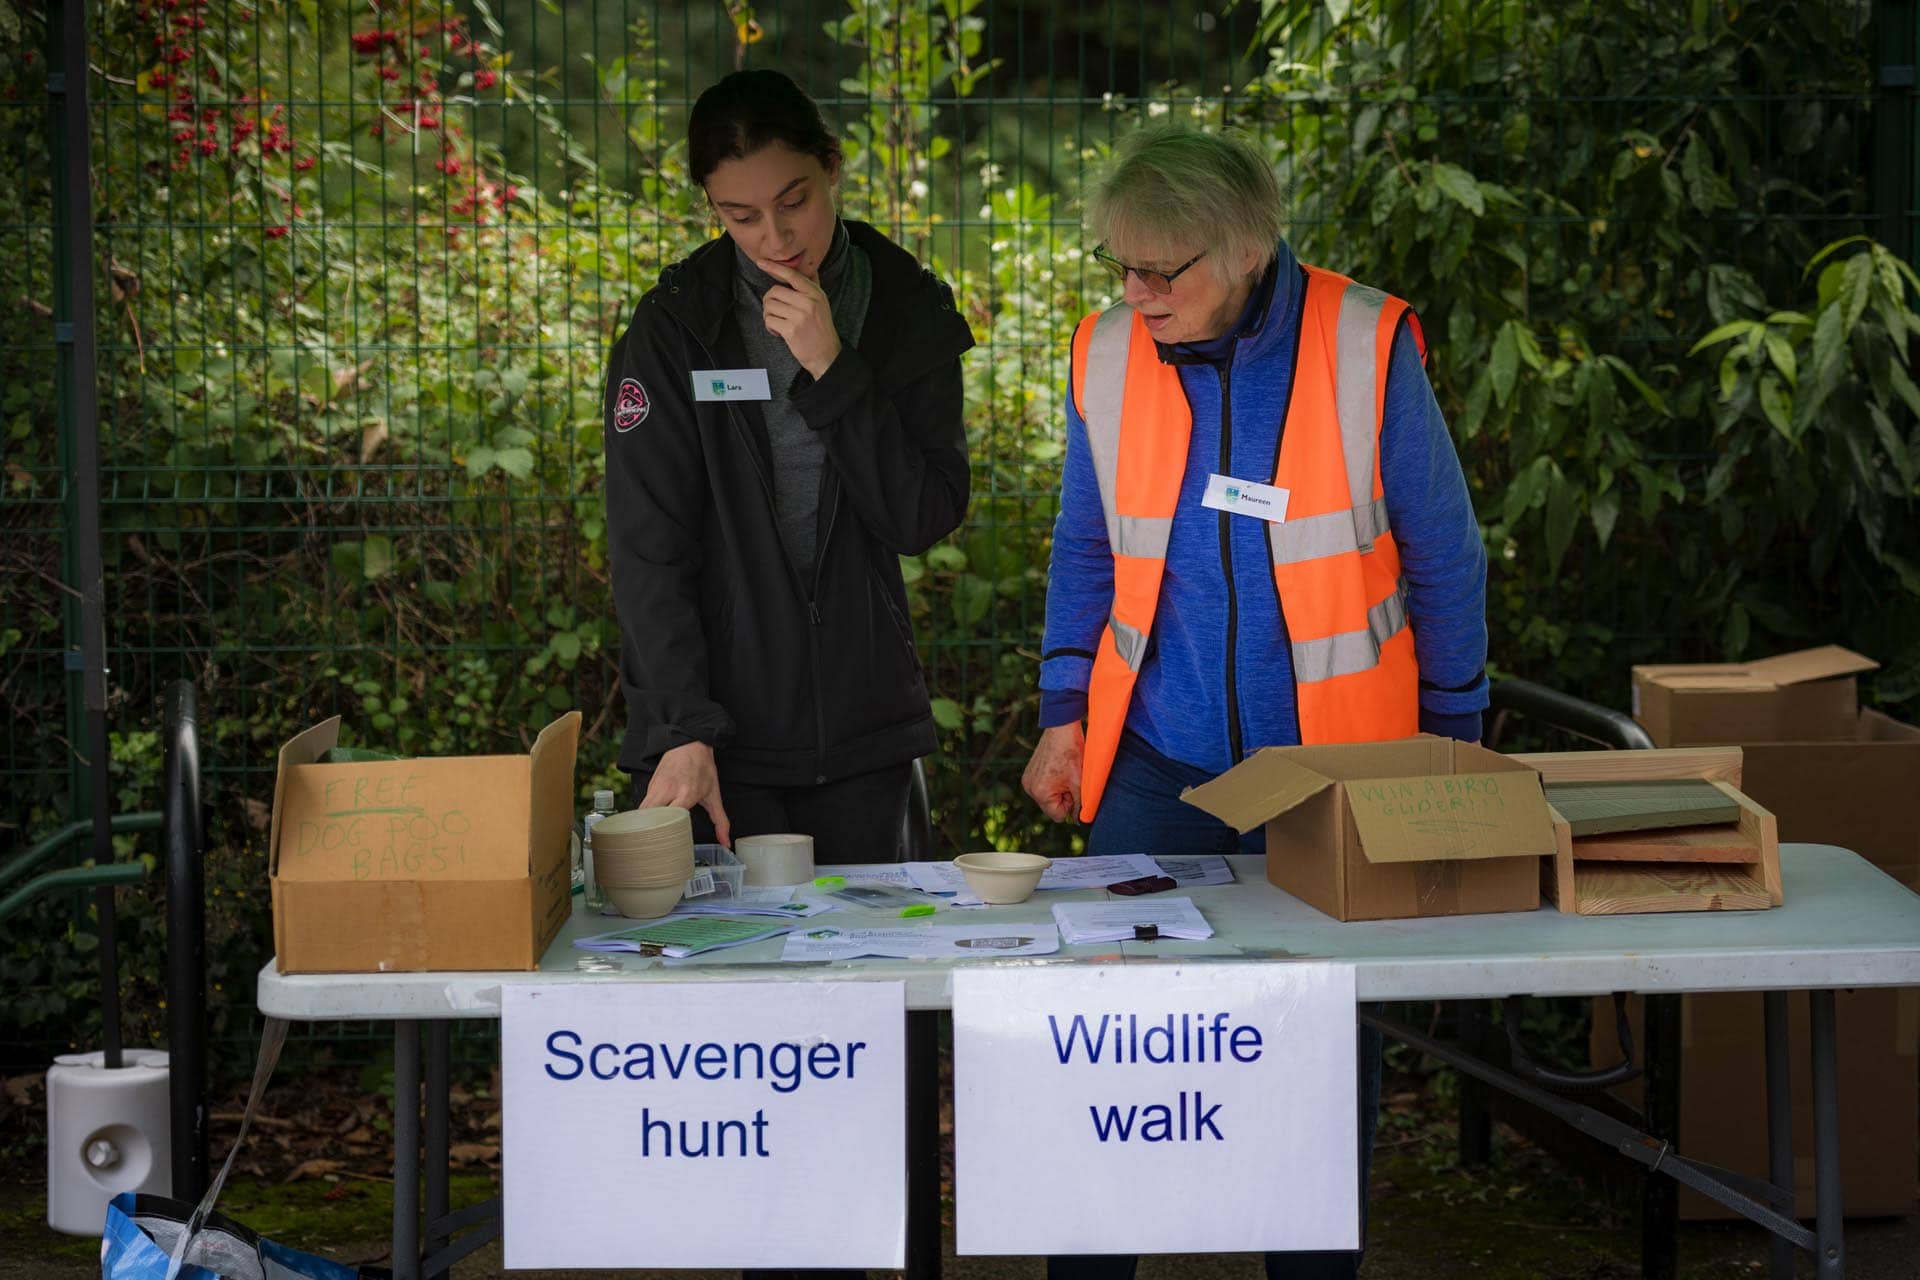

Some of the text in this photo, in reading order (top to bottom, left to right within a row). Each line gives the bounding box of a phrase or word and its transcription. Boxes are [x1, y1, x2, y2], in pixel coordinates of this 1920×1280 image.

[1241, 493, 1271, 506] Maureen
[324, 775, 427, 807] FREE
[1360, 784, 1414, 801] WIN
[1423, 779, 1436, 796] A
[297, 810, 472, 857] DOG POO
[1049, 1013, 1263, 1063] Wildlife
[545, 1031, 867, 1094] Scavenger
[643, 1109, 771, 1159] hunt
[1089, 1092, 1225, 1143] walk
